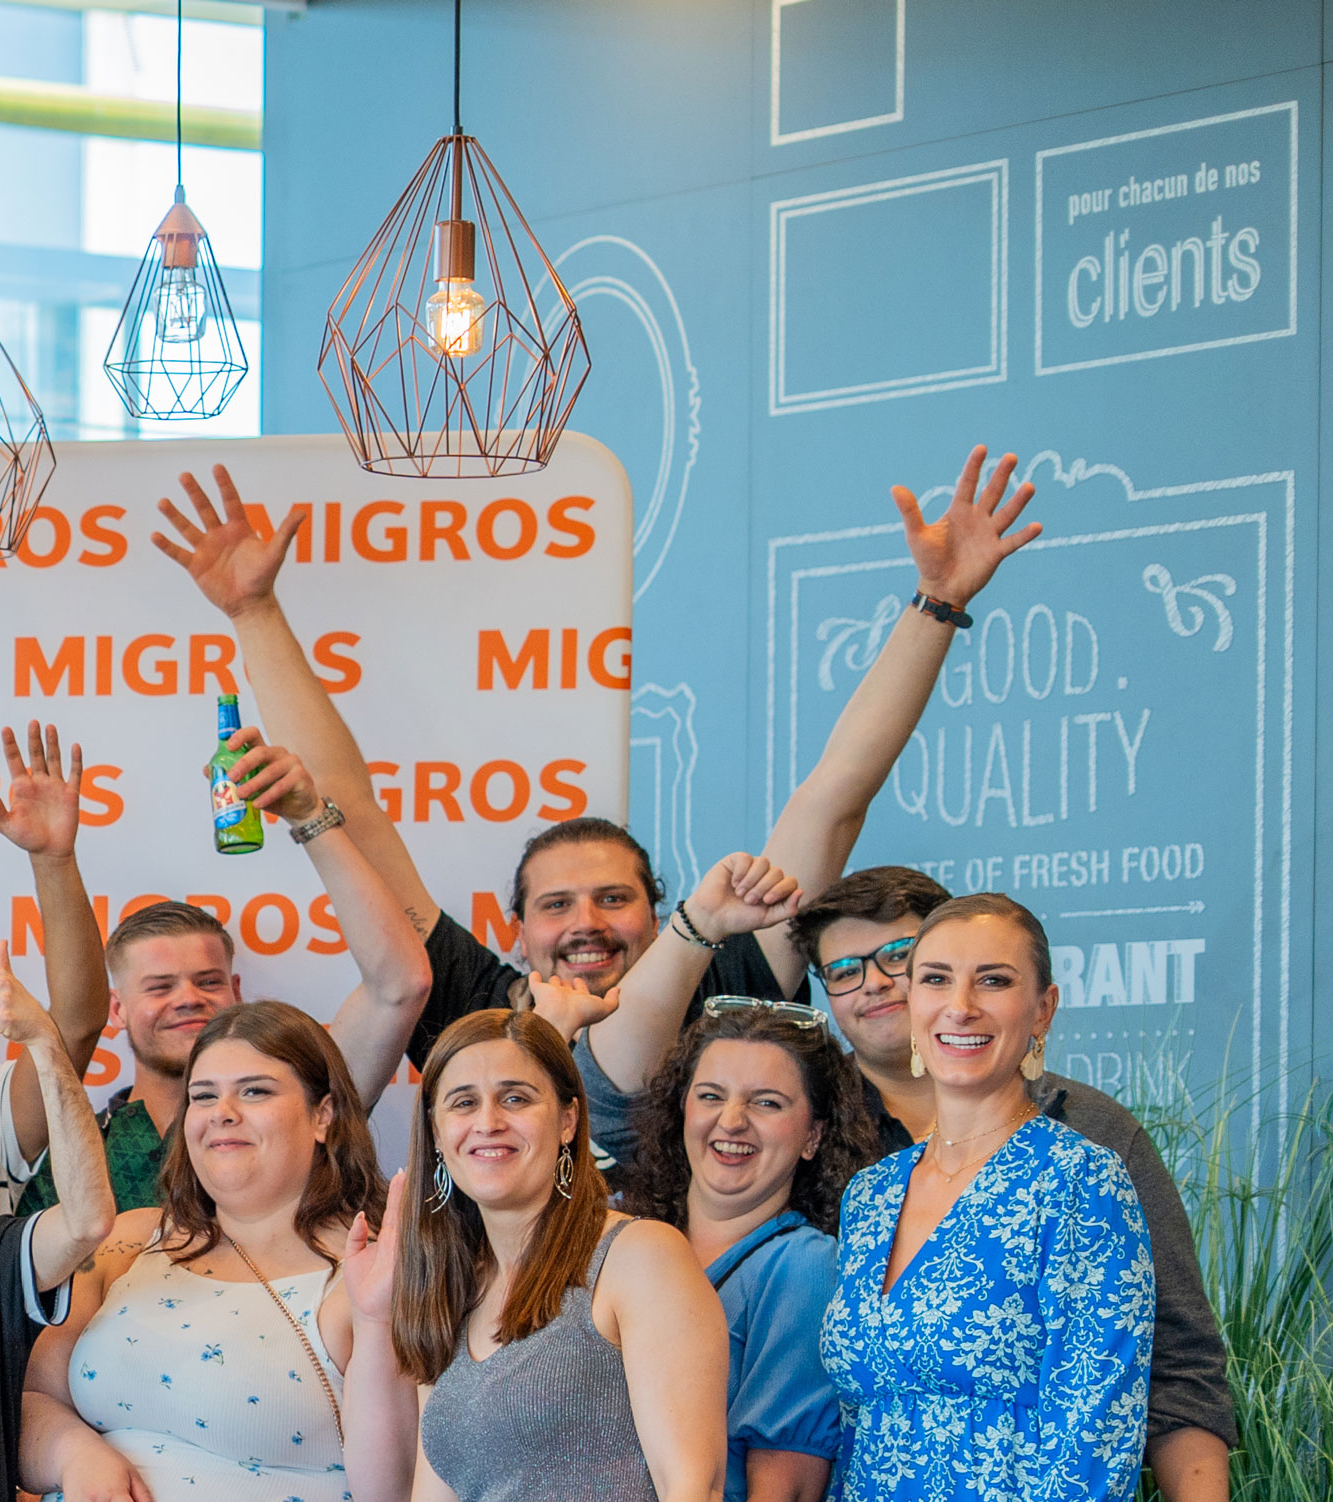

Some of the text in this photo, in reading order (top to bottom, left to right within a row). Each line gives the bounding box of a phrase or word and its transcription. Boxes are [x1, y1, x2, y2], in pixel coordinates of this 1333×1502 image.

[1069, 160, 1261, 225] pour chacun de nos
[1067, 215, 1261, 328] clients
[14, 631, 363, 697] MIGRS
[941, 603, 1099, 707] GOOD
[265, 759, 589, 824] GROS
[893, 708, 1151, 828] QUALITY
[965, 856, 1003, 893] OF
[1013, 849, 1109, 890] FRESH
[1121, 843, 1205, 883] FOOD
[1051, 938, 1206, 1010] RANT
[1066, 1050, 1195, 1108] DRINK
